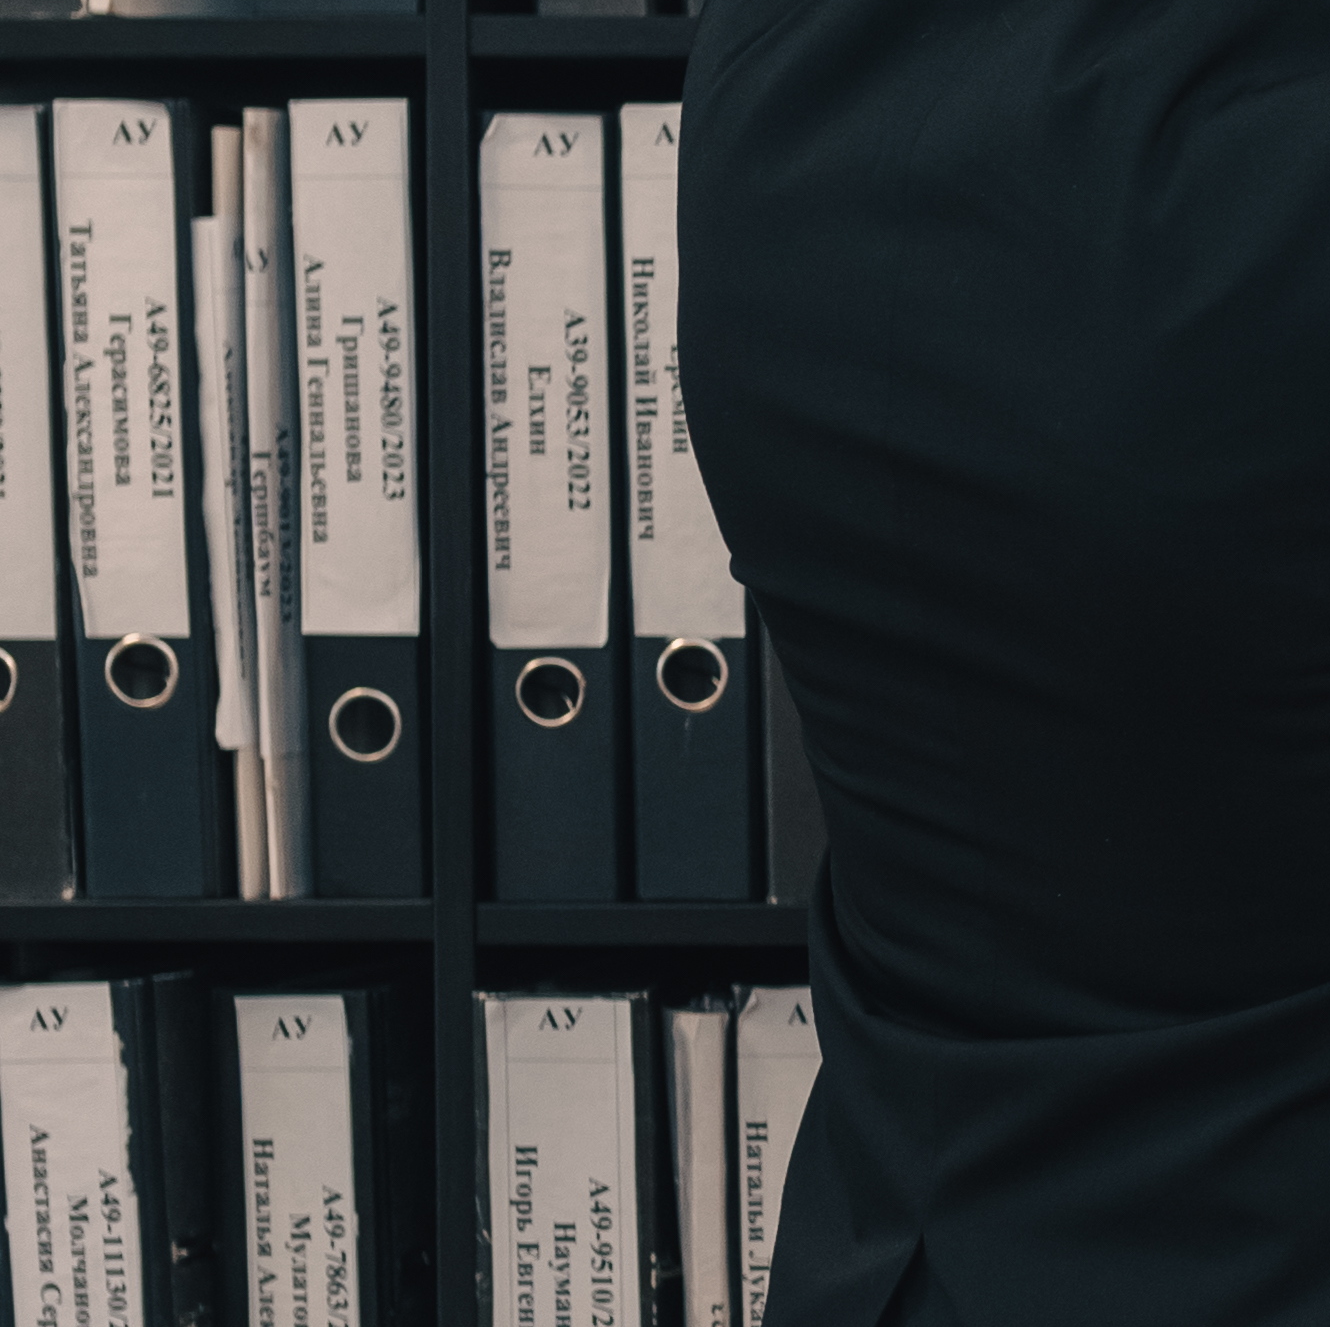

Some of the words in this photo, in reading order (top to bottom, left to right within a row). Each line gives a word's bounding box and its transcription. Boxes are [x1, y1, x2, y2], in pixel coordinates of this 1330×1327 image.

[111, 119, 158, 148] АУ
[324, 119, 370, 148] АУ
[532, 131, 581, 159] АУ
[68, 221, 98, 345] Татьяна
[303, 256, 327, 348] Алина
[487, 248, 514, 405] Владислав
[631, 257, 658, 386] Николай
[101, 314, 139, 487] Герасимова
[145, 297, 176, 498] А49-6825/2021
[306, 357, 335, 544] Геннадьевна
[334, 315, 369, 483] Гришанова
[527, 365, 554, 456] Елхин
[563, 313, 594, 512] А39-9053/2022
[72, 356, 101, 579] Александровна
[486, 414, 516, 572] Андреевич
[634, 396, 662, 541] Иванович
[29, 1006, 69, 1033] АУ
[272, 1014, 313, 1042] АУ
[537, 1006, 583, 1032] АУ
[29, 1125, 59, 1274] Анастасия
[251, 1137, 279, 1258] Наталья
[510, 1145, 541, 1233] Игорь
